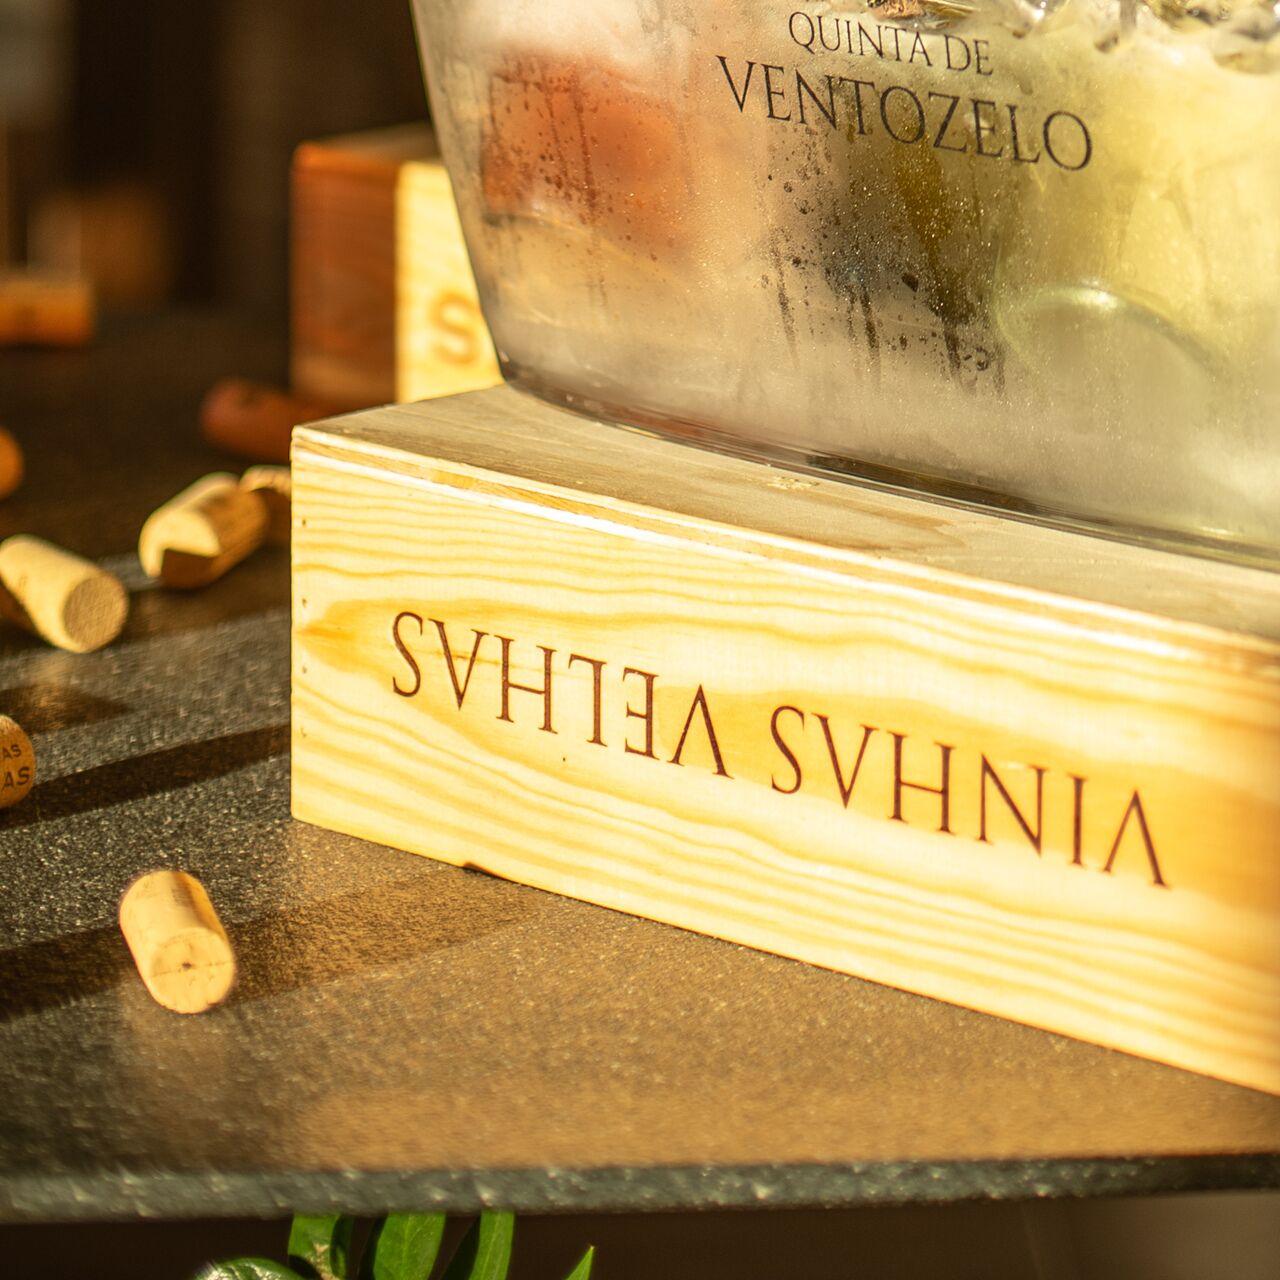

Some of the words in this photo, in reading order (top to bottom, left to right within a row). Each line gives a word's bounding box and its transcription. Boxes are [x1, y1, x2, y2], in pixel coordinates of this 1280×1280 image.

[715, 55, 1093, 171] VENTOZELO
[788, 11, 932, 67] QUINTA
[946, 33, 995, 76] DE
[391, 610, 736, 781] VELHAS
[769, 704, 1172, 889] VINHAS
